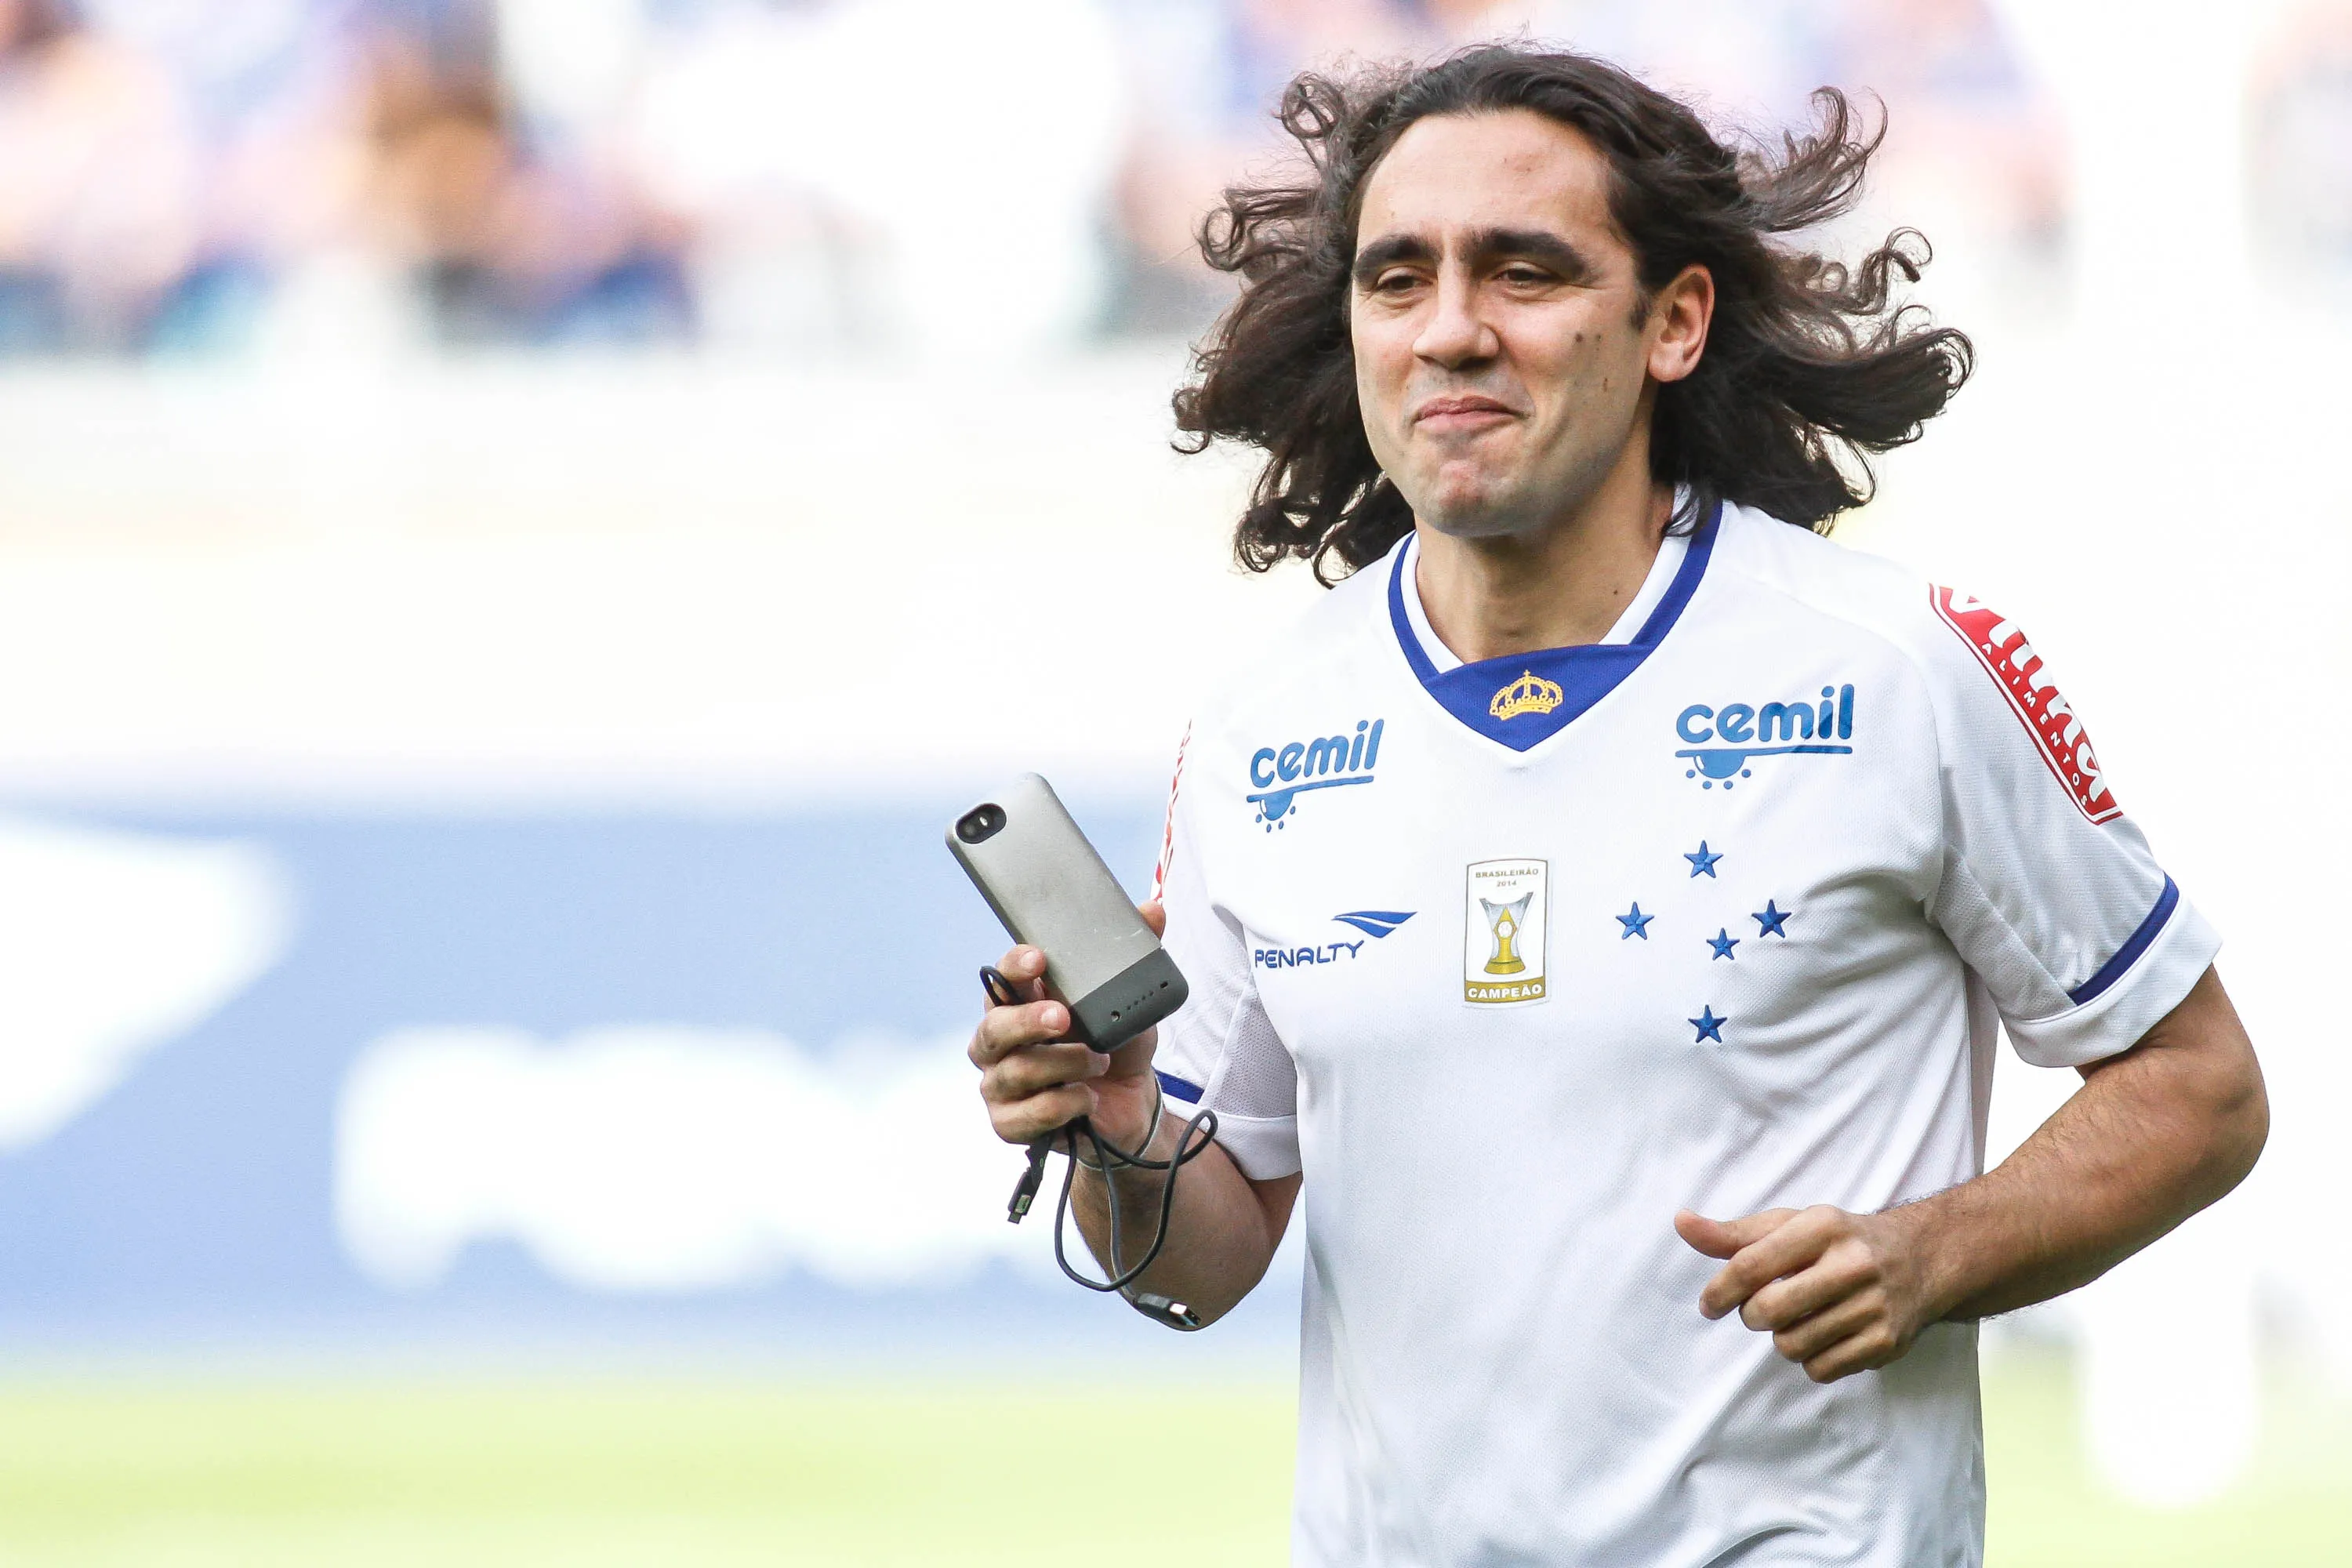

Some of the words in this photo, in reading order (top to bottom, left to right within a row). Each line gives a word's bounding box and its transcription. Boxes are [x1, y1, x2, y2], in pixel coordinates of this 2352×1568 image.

[1676, 684, 1854, 743] cemil
[1982, 642, 2088, 806] ALIMENTOS
[1250, 719, 1384, 788] cemil
[1475, 867, 1539, 878] BRASILEIRÃO
[1255, 940, 1364, 968] PENALTY
[1468, 984, 1543, 999] CAMPEÃO
